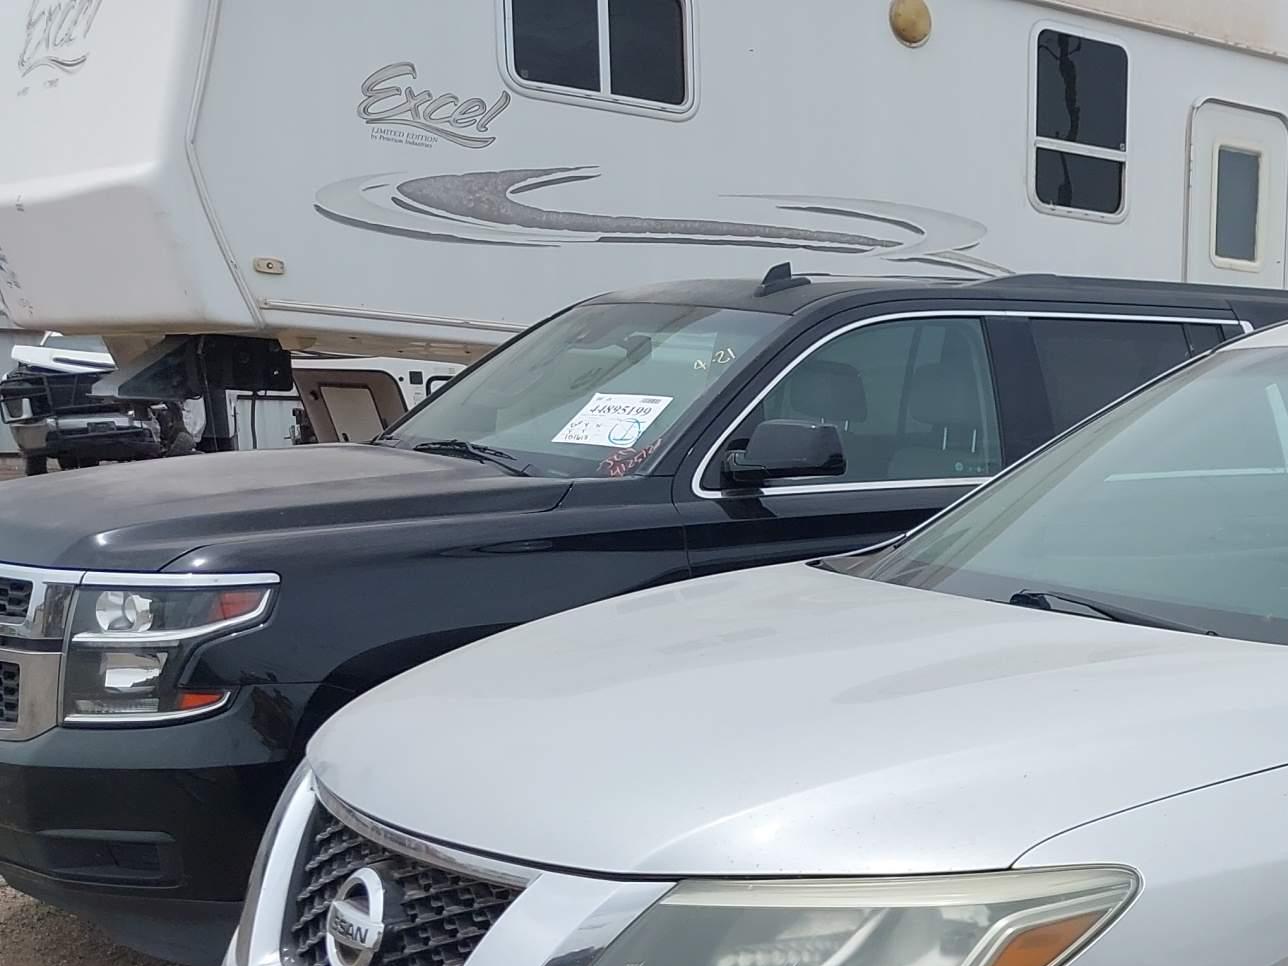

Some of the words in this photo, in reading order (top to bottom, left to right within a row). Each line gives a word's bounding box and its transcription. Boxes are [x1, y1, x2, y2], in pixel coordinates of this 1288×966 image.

[357, 61, 511, 132] Excel
[371, 127, 405, 138] LIMITED
[406, 132, 439, 143] EDITION
[589, 404, 653, 416] 44895199
